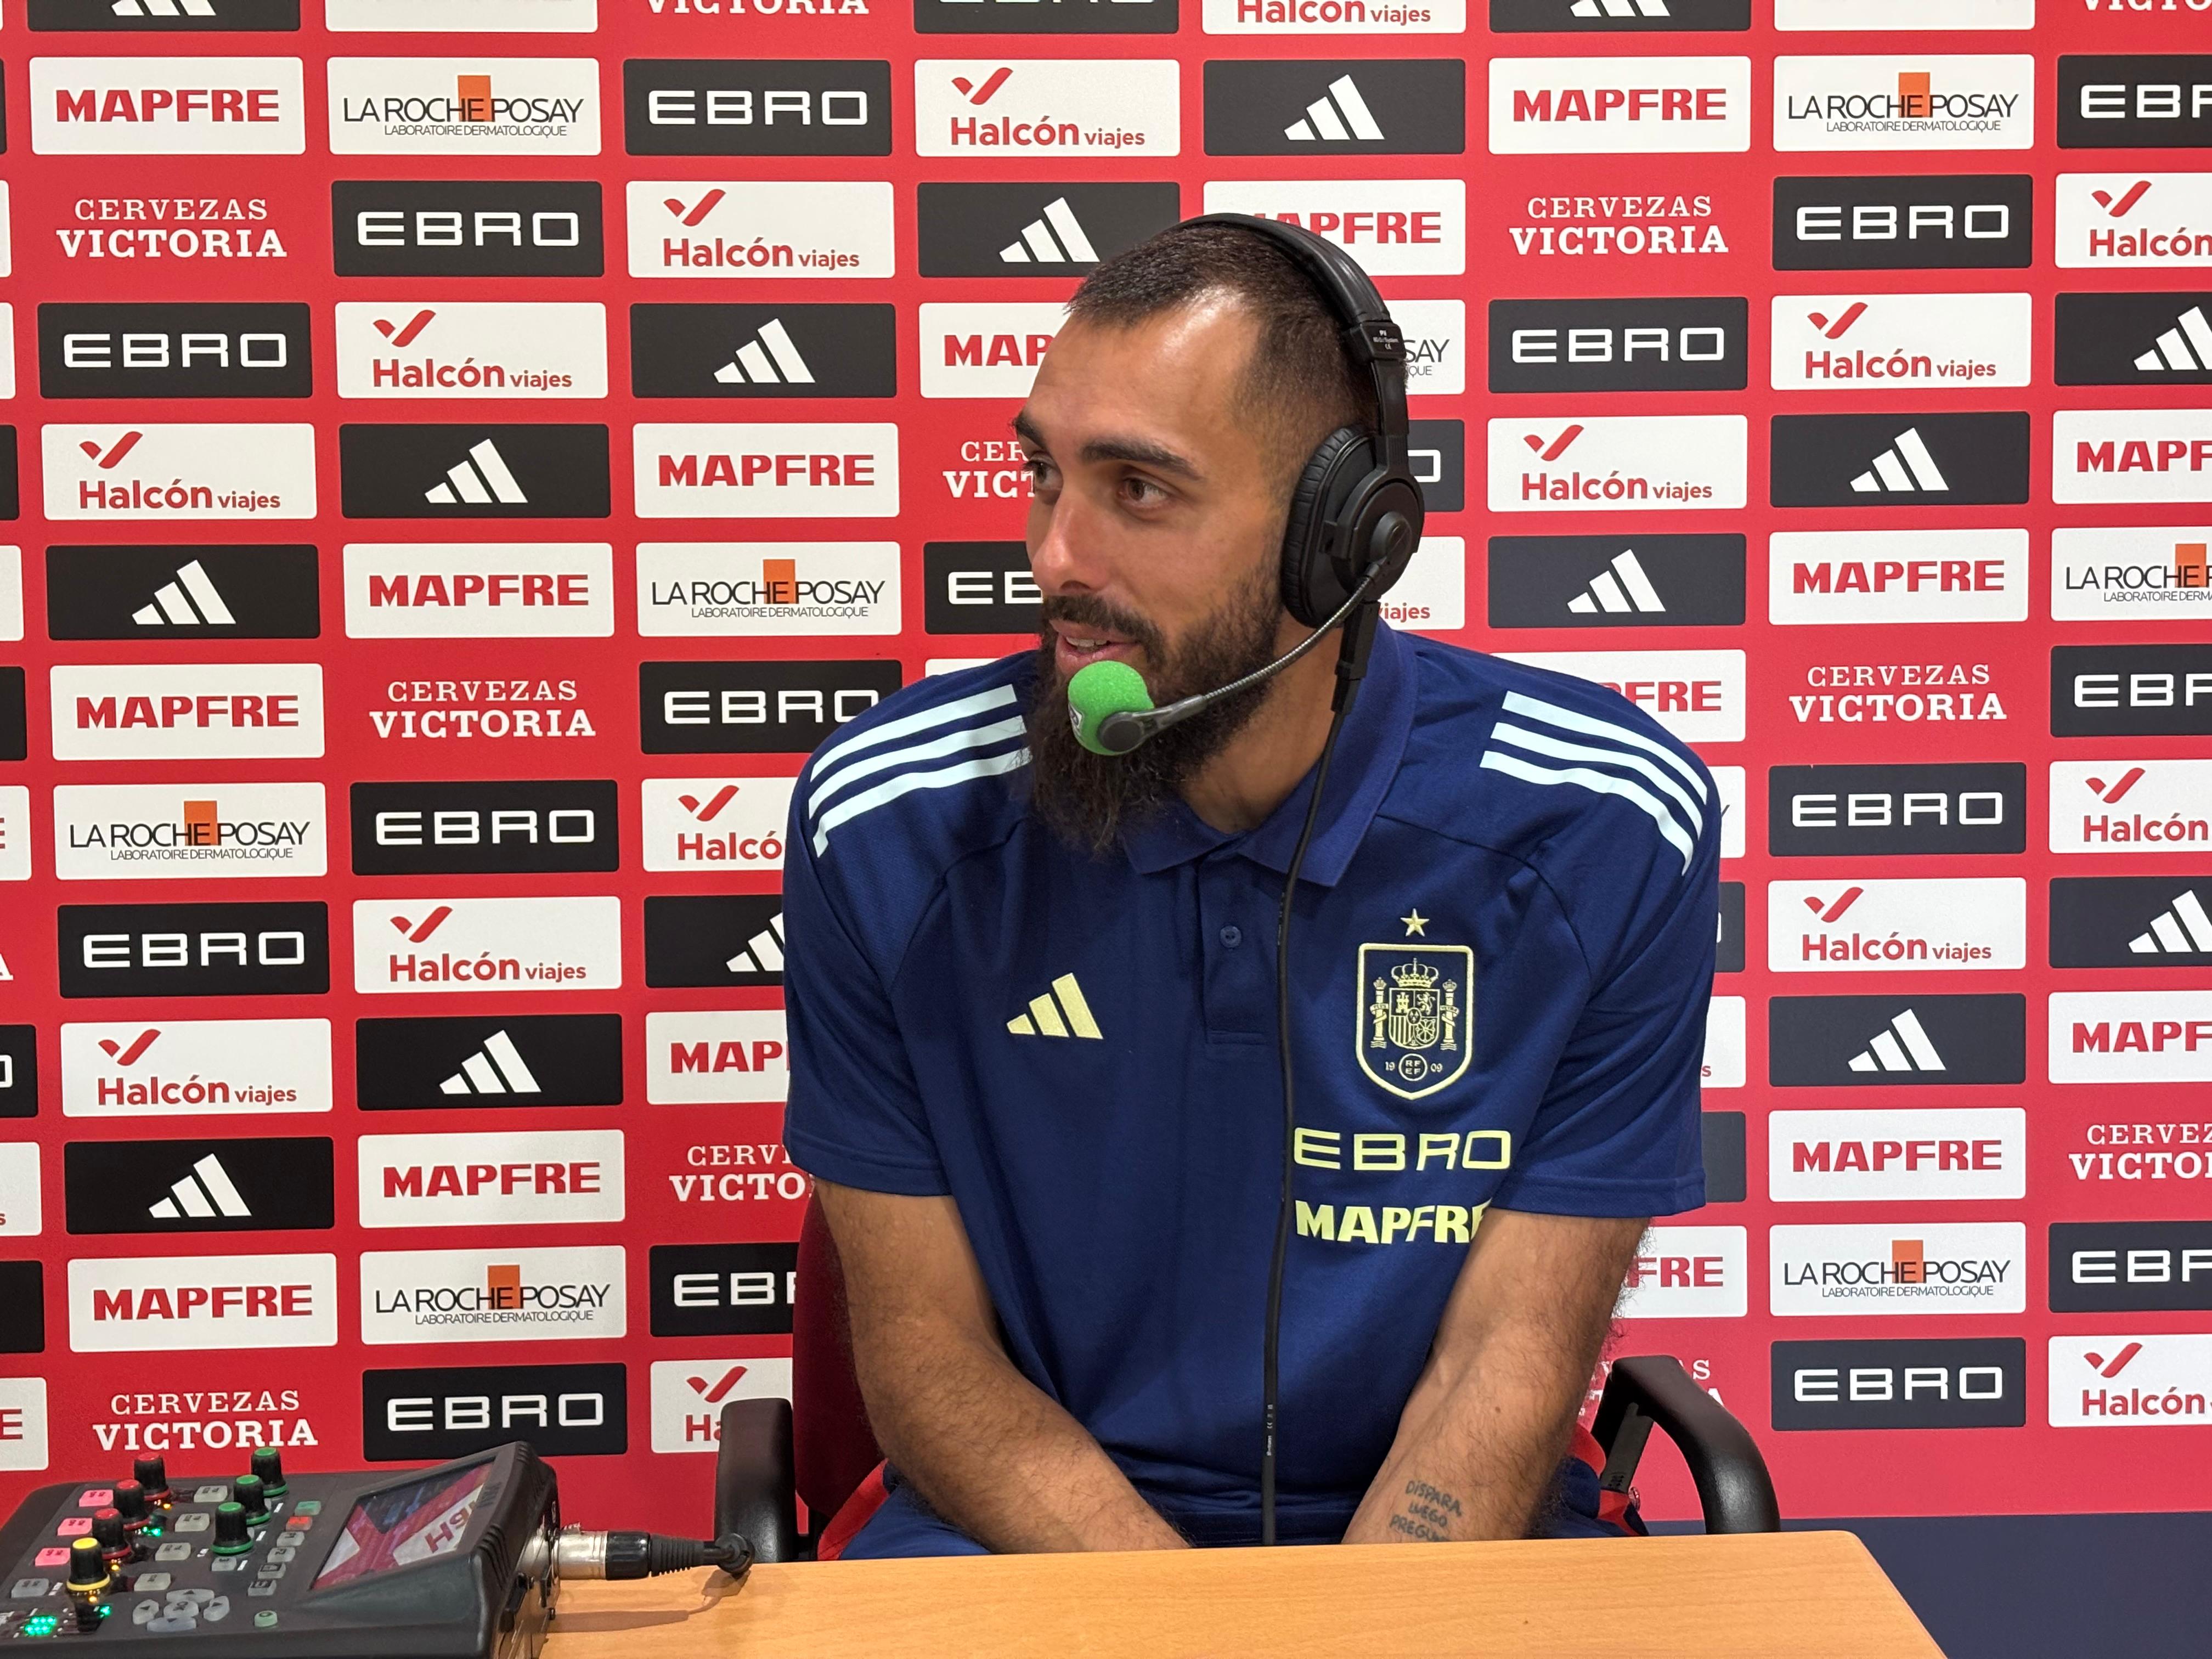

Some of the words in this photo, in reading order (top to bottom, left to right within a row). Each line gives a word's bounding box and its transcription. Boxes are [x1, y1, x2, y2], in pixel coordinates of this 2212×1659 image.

[1370, 5, 1430, 26] viajes
[57, 90, 279, 122] MAPFRE
[344, 98, 380, 122] LA
[385, 98, 485, 122] ROCHE
[491, 98, 584, 122] POSAY
[649, 91, 867, 125] EBRO
[1514, 89, 1726, 121] MAPFRE
[1789, 96, 1822, 119] LA
[1827, 95, 1923, 119] ROCHE
[1929, 94, 2018, 118] POSAY
[385, 125, 462, 135] LABORATOIRE
[464, 126, 566, 137] DERMATOLOGIQUE
[951, 116, 1079, 145] Halcón
[1084, 128, 1144, 149] viajes
[1827, 121, 1900, 131] LABORATOIRE
[1903, 121, 2000, 132] DERMATOLOGIQUE
[75, 199, 267, 220] CERVEZAS
[1528, 196, 1711, 218] CERVEZAS
[358, 212, 579, 246] EBRO
[1254, 212, 1441, 244] PFRE
[1797, 205, 2008, 240] EBRO
[57, 229, 287, 257] VICTORIA
[664, 237, 793, 267] Halcón
[799, 250, 859, 270] viajes
[1509, 225, 1728, 255] VICTORIA
[64, 334, 286, 367] EBRO
[1402, 339, 1450, 363] SAY
[1513, 328, 1724, 363] EBRO
[374, 358, 504, 387] Halcón
[510, 370, 572, 391] viajes
[1806, 349, 1931, 378] Halcón
[1937, 360, 1996, 380] viajes
[659, 455, 874, 486] MAPFRE
[943, 471, 1035, 498] VICT
[80, 479, 212, 509] Halcón
[218, 491, 280, 511] viajes
[1522, 471, 1647, 500] Halcón
[1653, 482, 1712, 501] viajes
[370, 575, 588, 606] MAPFRE
[1793, 560, 2004, 593] MAPFRE
[2066, 567, 2099, 590] LA
[2106, 566, 2200, 589] ROCHE
[652, 582, 687, 605] LA
[692, 582, 789, 605] ROCHE
[795, 581, 885, 604] POSAY
[692, 607, 766, 617] LABORATOIRE
[769, 607, 867, 618] DERMATOLOGIQUE
[1808, 664, 1989, 686] CERVEZAS
[388, 681, 577, 702] CERVEZAS
[1606, 681, 1722, 712] FRE
[77, 696, 298, 729] MAPFRE
[664, 690, 879, 725] EBRO
[1789, 693, 2007, 722] VICTORIA
[369, 709, 596, 738] VICTORIA
[1792, 793, 2002, 827] EBRO
[70, 825, 106, 848] LA
[111, 823, 211, 847] ROCHE
[217, 822, 310, 845] POSAY
[376, 810, 594, 845] EBRO
[2084, 813, 2208, 842] Halcón
[111, 850, 188, 860] LABORATOIRE
[190, 848, 292, 860] DERMATOLOGIQUE
[83, 932, 304, 968] EBRO
[1803, 932, 1927, 961] Halcón
[1932, 943, 1991, 962] viajes
[390, 952, 520, 981] Halcón
[526, 962, 586, 983] viajes
[670, 1041, 789, 1073] MAP
[98, 1075, 229, 1105] Halcón
[235, 1085, 296, 1105] viajes
[1295, 1127, 1510, 1170] EBRO
[1793, 1140, 2001, 1172] MAPFRE
[384, 1163, 600, 1197] MAPFRE
[2069, 1152, 2212, 1180] VICTO
[669, 1172, 814, 1201] VICTO
[1785, 1263, 1818, 1285] LA
[1823, 1262, 1917, 1284] ROCHE
[1922, 1260, 2010, 1283] POSAY
[94, 1285, 312, 1321] MAPFRE
[376, 1290, 411, 1313] LA
[416, 1287, 516, 1312] ROCHE
[519, 1284, 610, 1309] POSAY
[674, 1272, 795, 1307] EB
[1822, 1287, 1894, 1297] LABORATOIRE
[1897, 1286, 1993, 1297] DERMATOLOGIQUE
[416, 1313, 491, 1324] LABORATOIRE
[493, 1311, 592, 1322] DERMATOLOGIQUE
[1795, 1367, 2002, 1401] EBRO
[111, 1391, 298, 1414] CERVEZAS
[388, 1393, 603, 1431] EBRO
[2083, 1387, 2205, 1415] Halcón
[93, 1419, 318, 1449] VICTORIA
